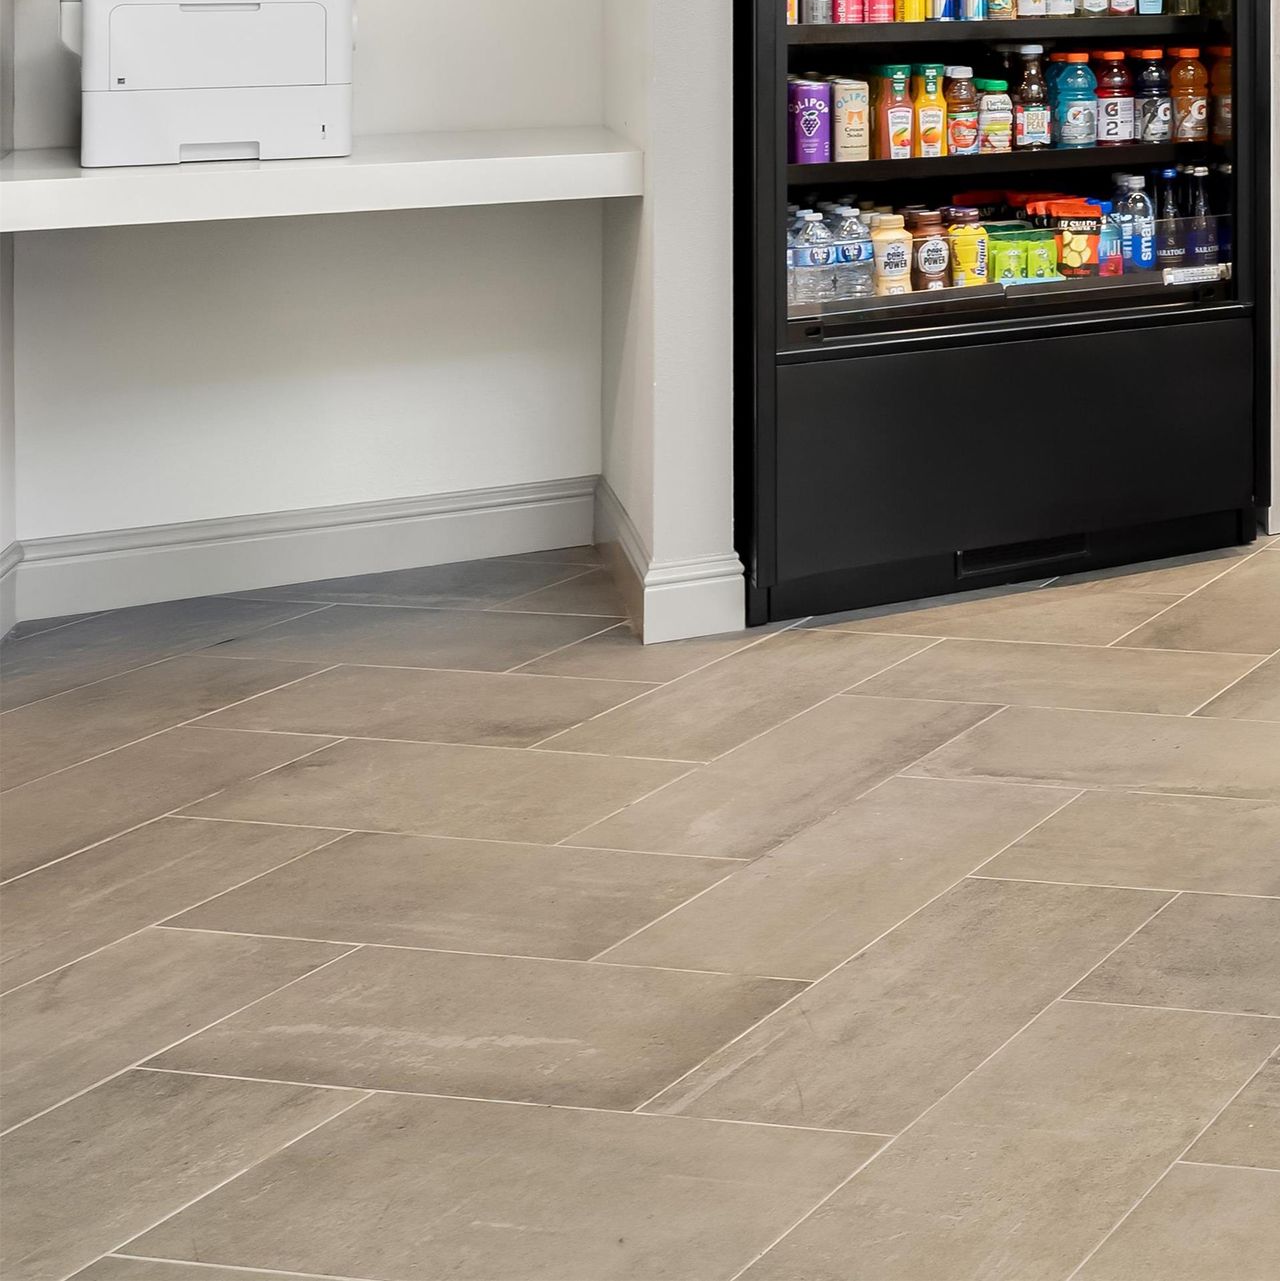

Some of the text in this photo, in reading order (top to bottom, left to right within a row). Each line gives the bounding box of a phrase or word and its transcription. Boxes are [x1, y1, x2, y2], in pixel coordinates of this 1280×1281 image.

[1026, 121, 1046, 130] PEAK
[1106, 121, 1118, 136] 2
[1140, 216, 1152, 262] smart
[886, 250, 904, 261] CORE
[926, 248, 942, 256] CORE
[976, 238, 986, 276] Nesquik
[884, 260, 908, 271] POWER
[924, 256, 946, 266] POWER
